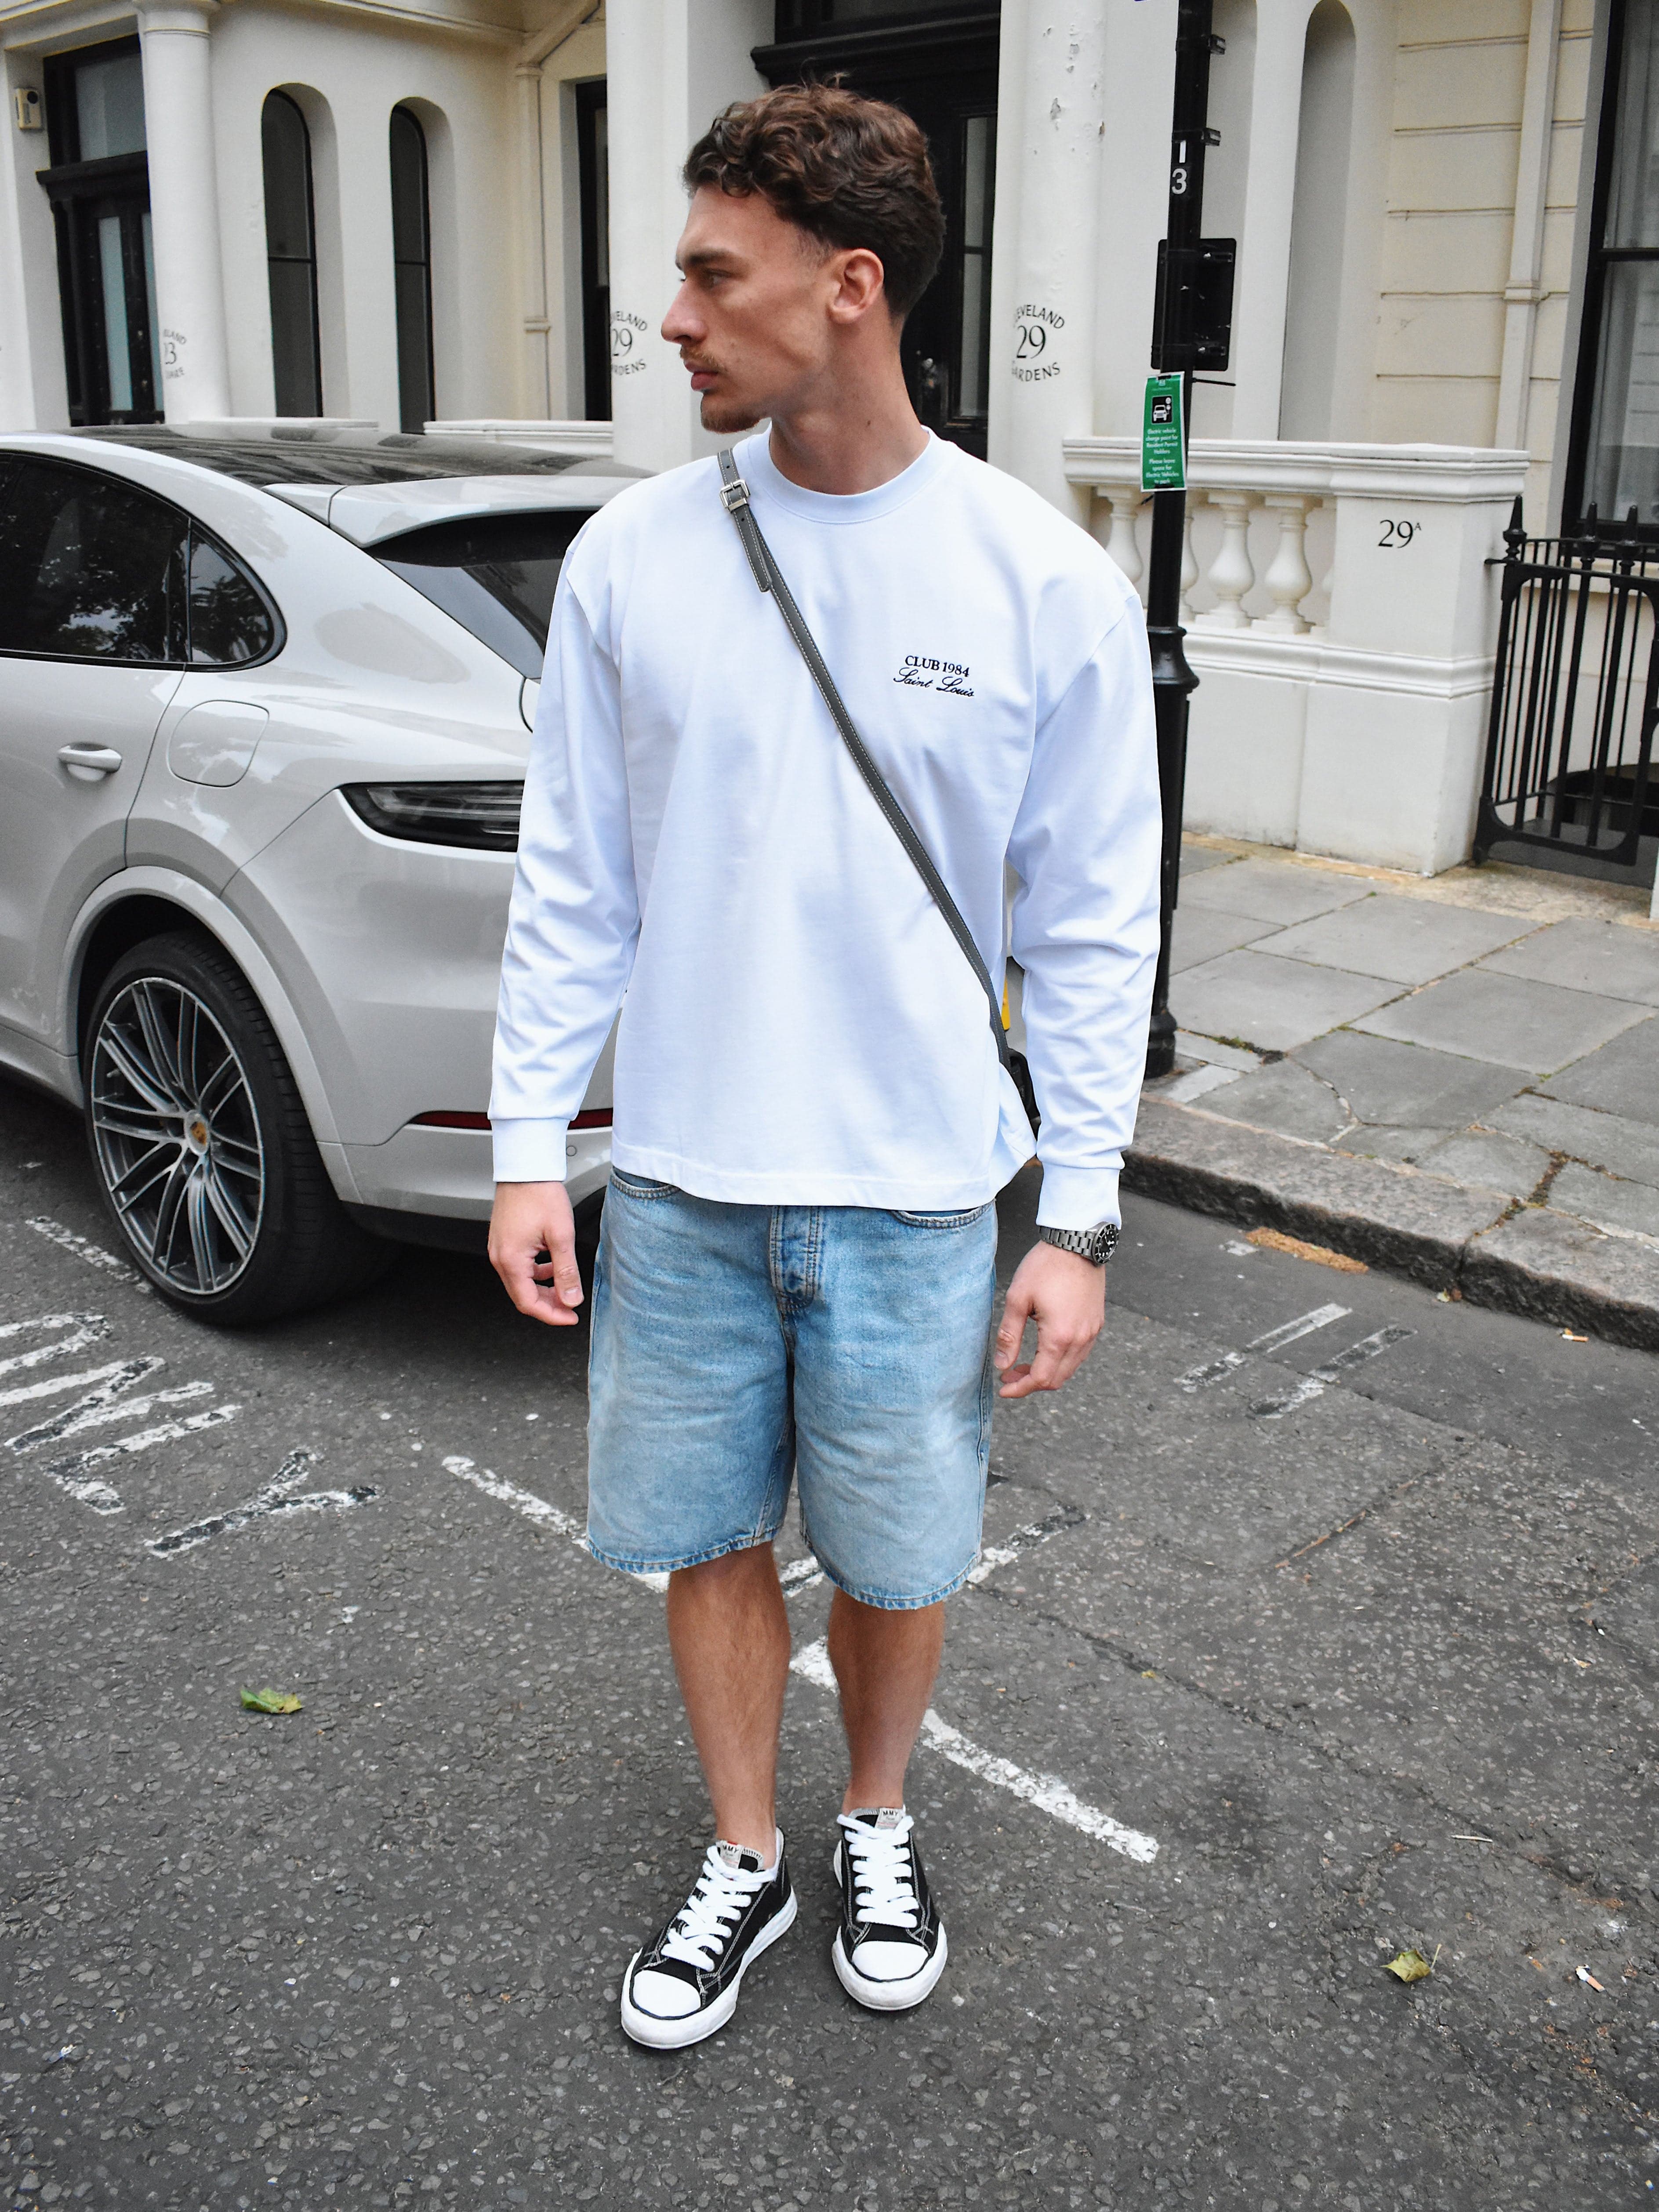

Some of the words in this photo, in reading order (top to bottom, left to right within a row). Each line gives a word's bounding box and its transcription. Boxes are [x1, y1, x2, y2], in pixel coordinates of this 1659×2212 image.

[1016, 325, 1046, 359] 29
[1012, 360, 1060, 381] ARDENS
[904, 655, 940, 671] CLUB
[942, 662, 970, 677] 1984
[893, 667, 933, 688] Saint
[936, 676, 975, 697] Louis
